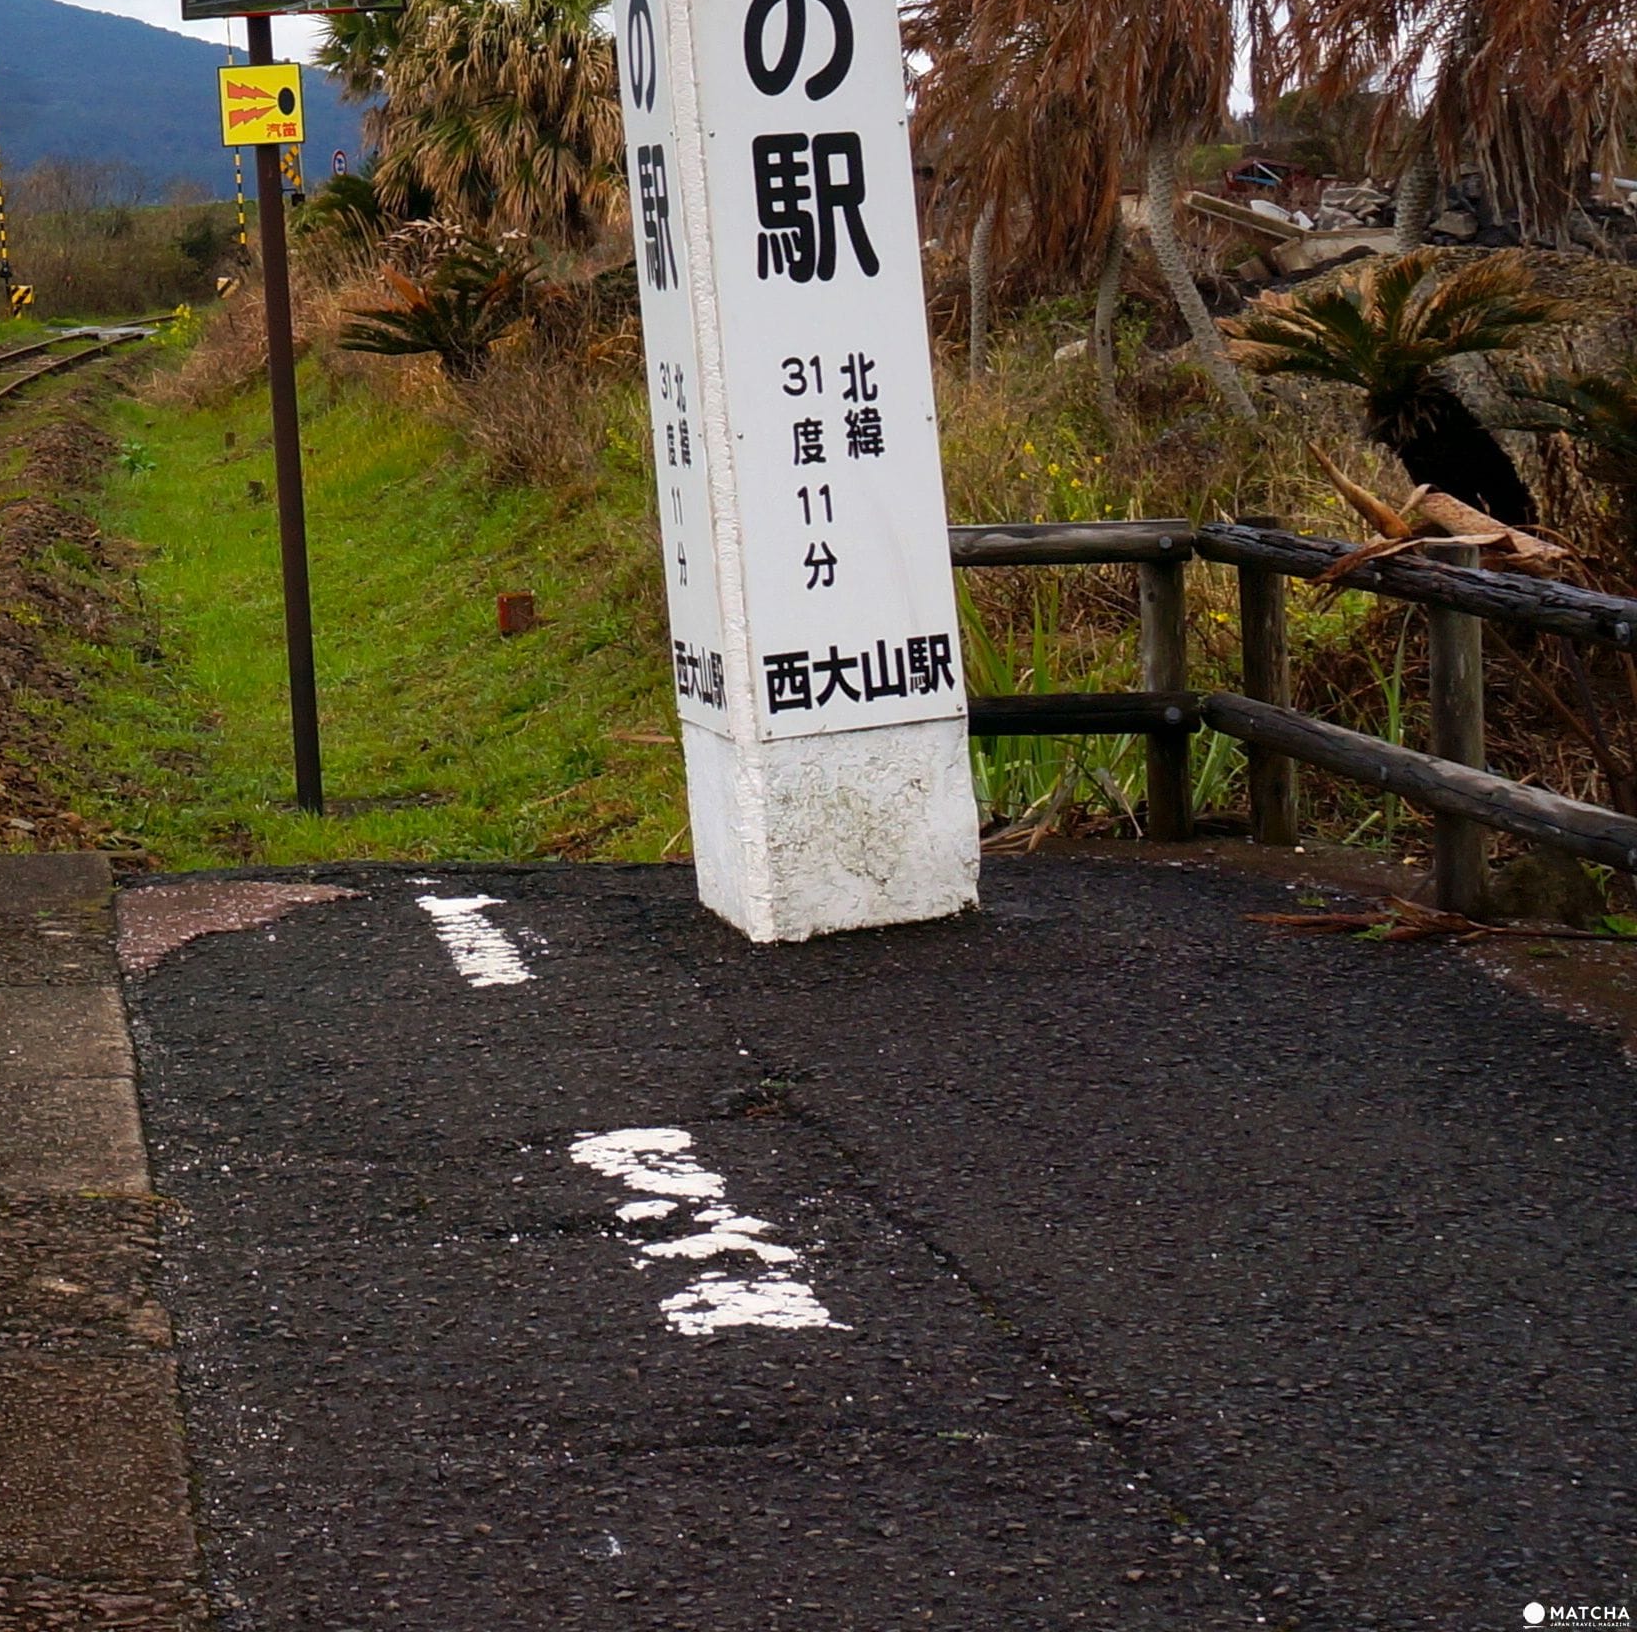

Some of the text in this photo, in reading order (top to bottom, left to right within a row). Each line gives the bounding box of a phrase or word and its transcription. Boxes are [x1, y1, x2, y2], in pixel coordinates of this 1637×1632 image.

[840, 351, 886, 460] 北緯
[674, 639, 728, 711] 西大山駅
[762, 632, 956, 714] 西大山駅
